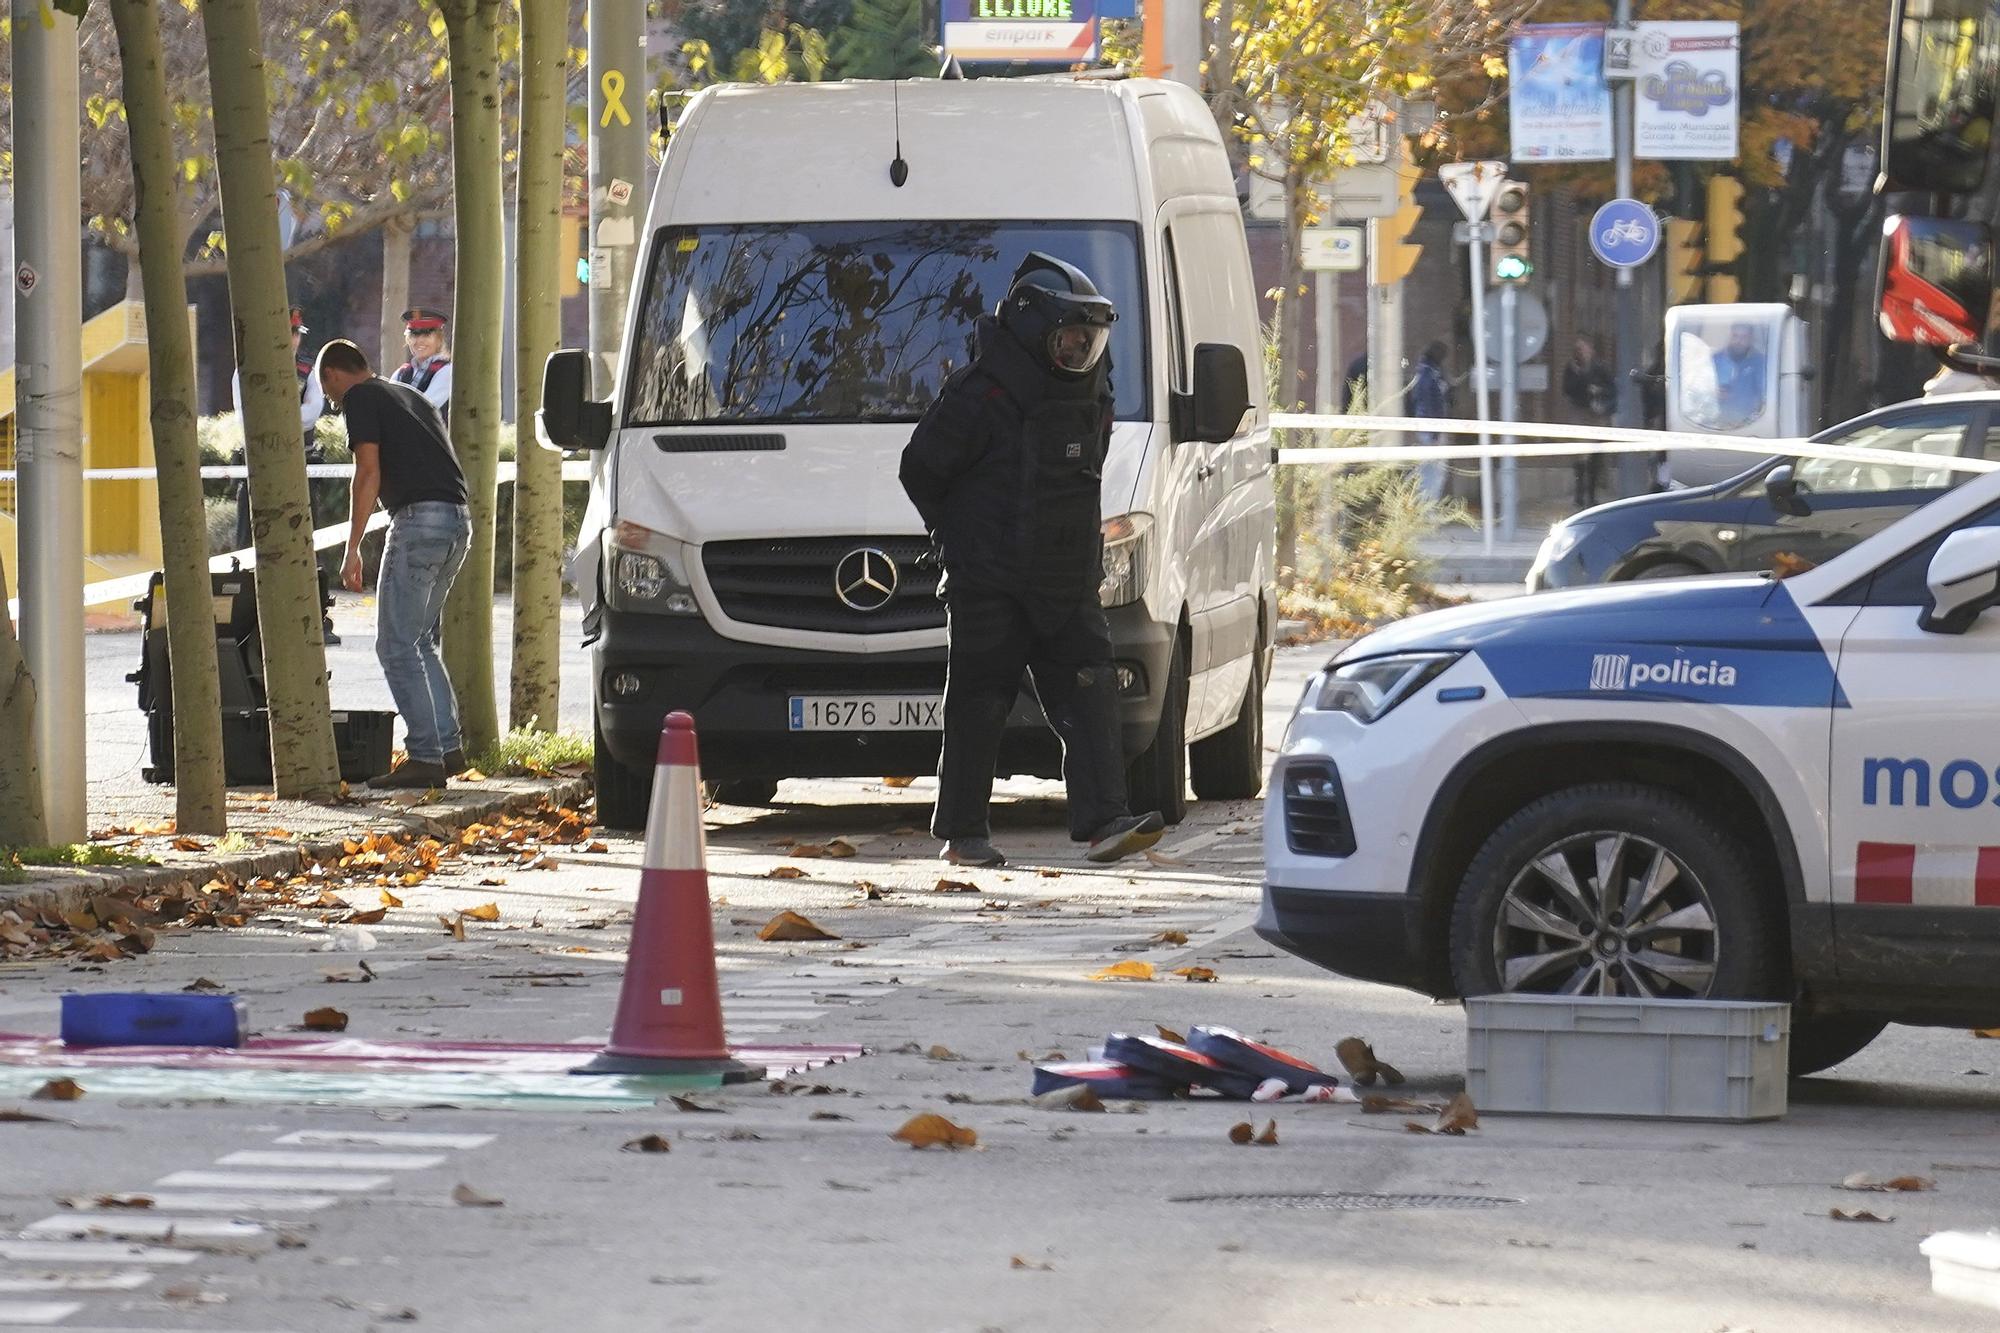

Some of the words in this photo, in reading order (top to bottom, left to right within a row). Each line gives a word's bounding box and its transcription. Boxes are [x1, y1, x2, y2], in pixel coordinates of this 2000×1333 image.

[985, 28, 1055, 43] empark
[1629, 659, 1738, 688] policia
[811, 702, 876, 727] 1676
[889, 702, 939, 726] JNX
[1863, 757, 2000, 809] mo
